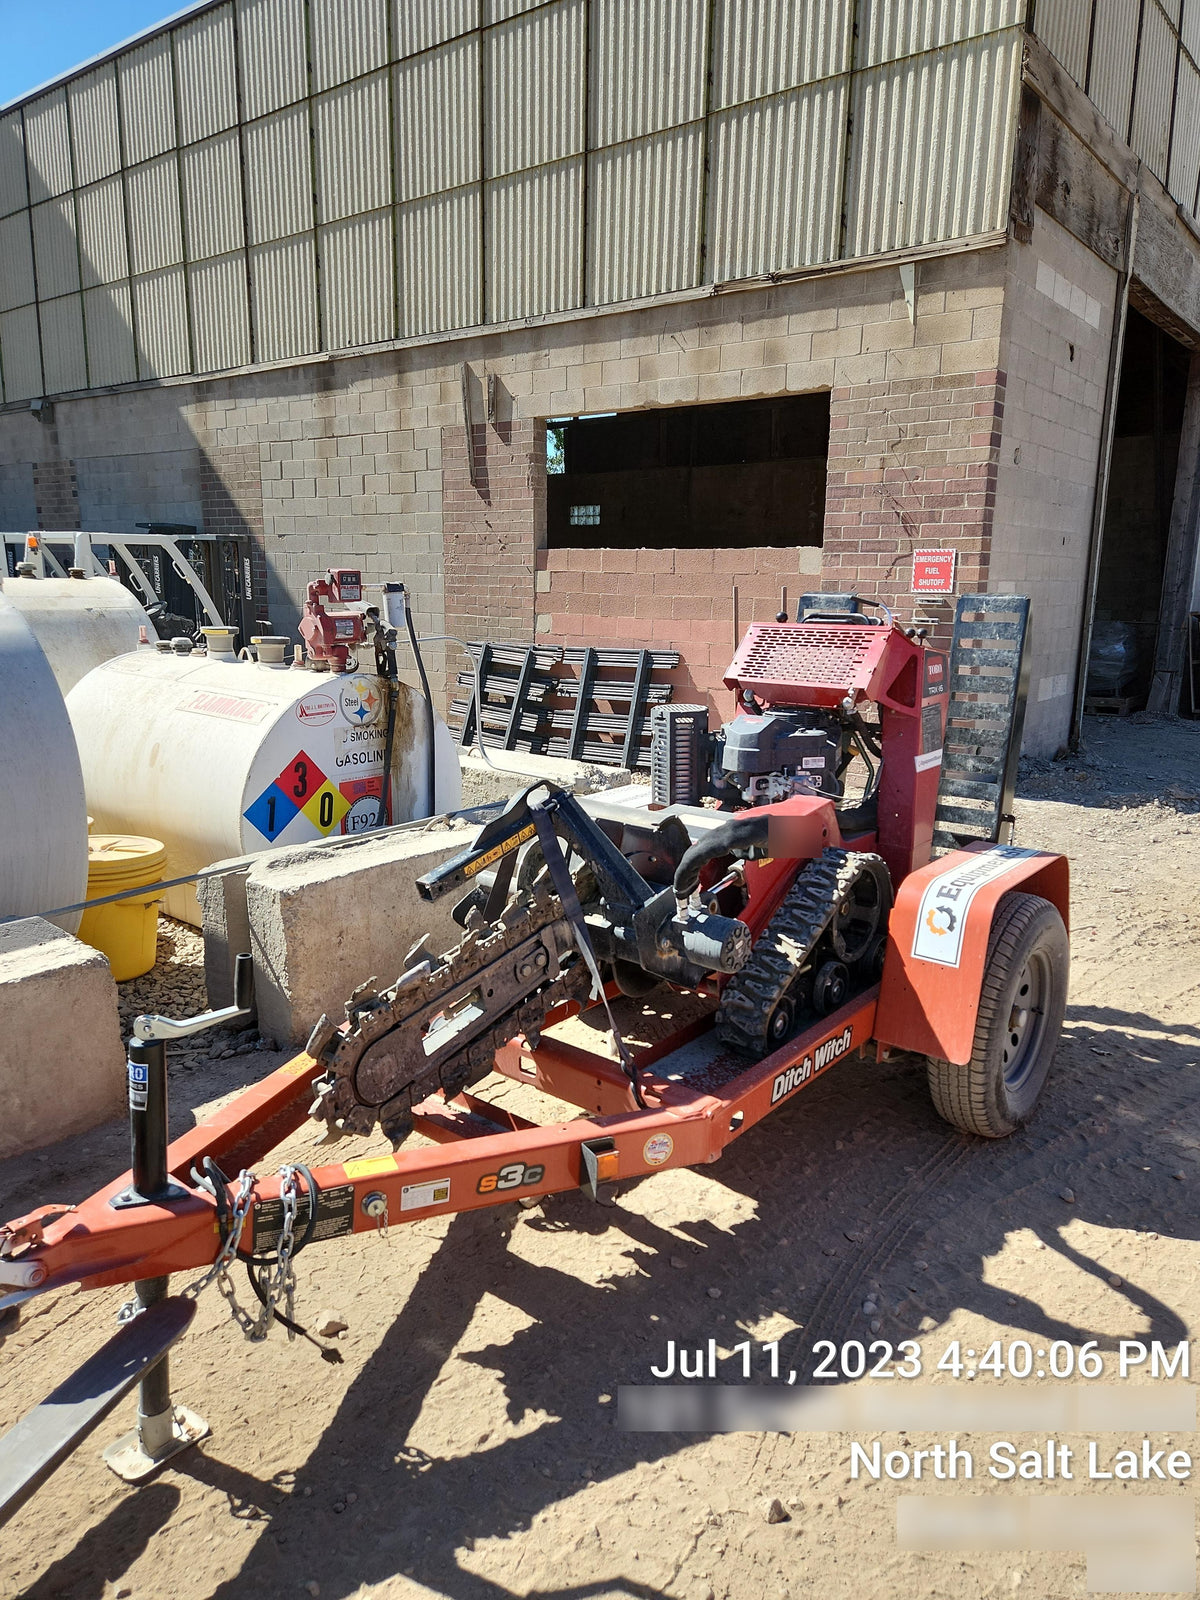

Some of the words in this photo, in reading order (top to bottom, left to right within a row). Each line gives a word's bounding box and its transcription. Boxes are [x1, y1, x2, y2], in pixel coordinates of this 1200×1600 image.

[915, 555, 952, 563] EMERGENCY
[925, 567, 940, 575] FUEL
[918, 578, 945, 586] SHUTOFF
[928, 664, 943, 675] TORO
[344, 698, 359, 707] Steel
[350, 728, 389, 742] SMOKING
[335, 749, 386, 767] GASOLIN
[293, 761, 307, 798] 3
[267, 795, 276, 832] 1
[319, 791, 334, 828] 0
[351, 812, 382, 831] F92
[129, 1065, 143, 1080] RO
[772, 1056, 812, 1104] Ditch
[814, 1026, 852, 1072] Witch
